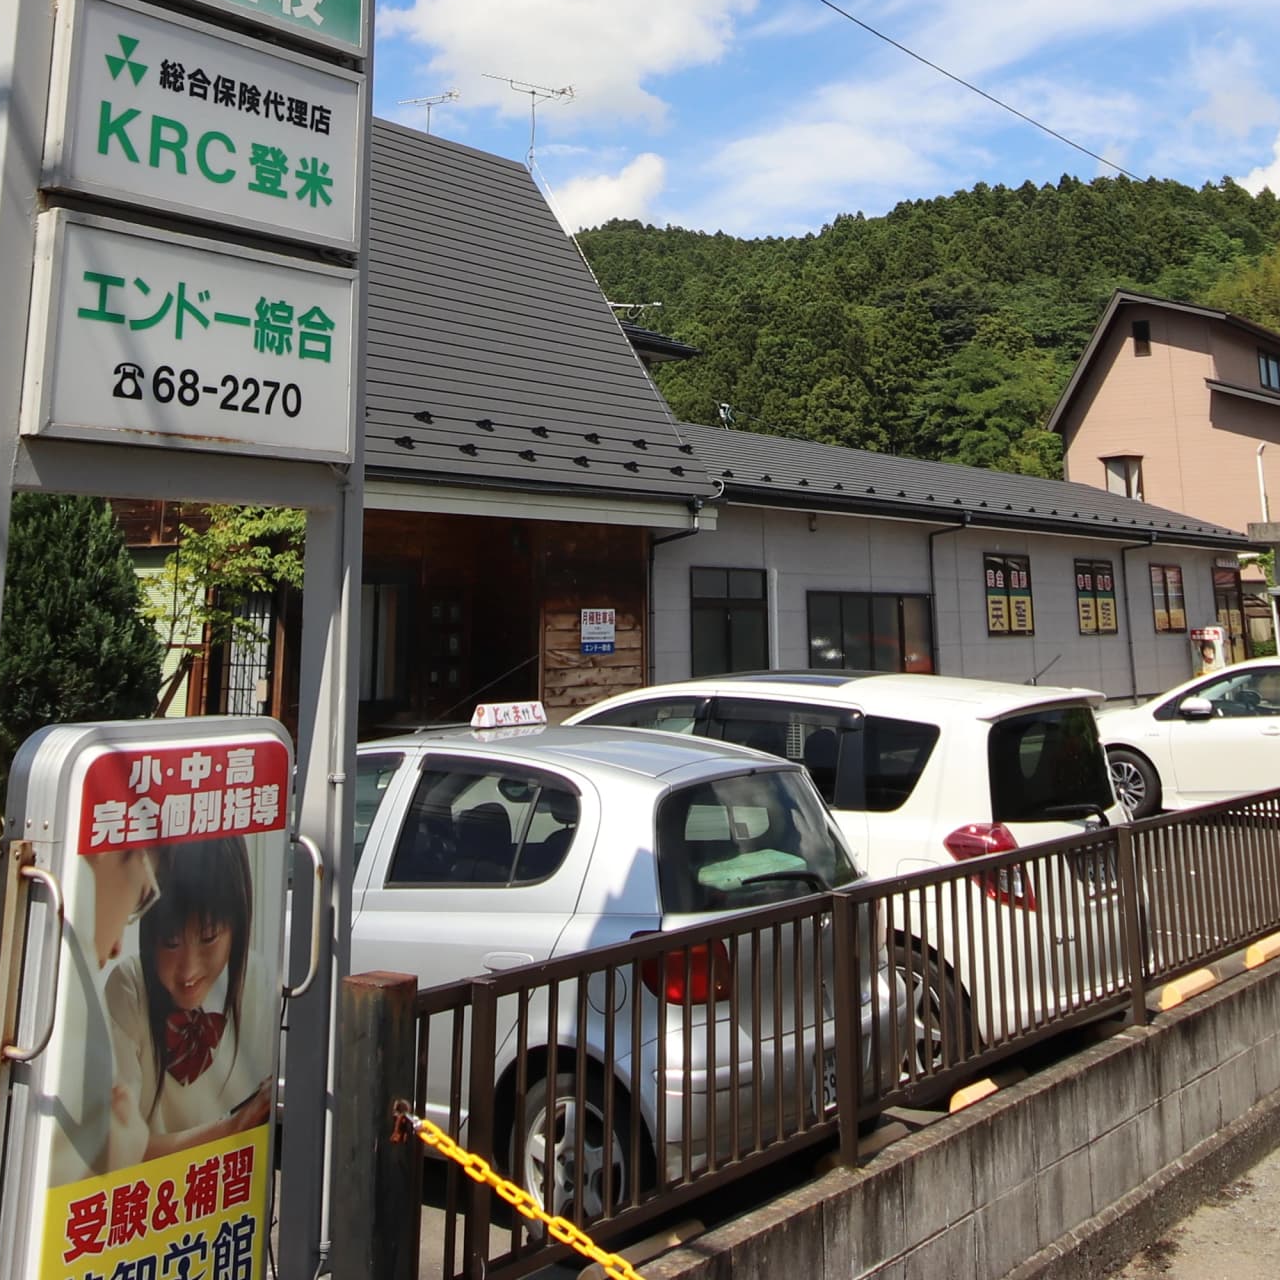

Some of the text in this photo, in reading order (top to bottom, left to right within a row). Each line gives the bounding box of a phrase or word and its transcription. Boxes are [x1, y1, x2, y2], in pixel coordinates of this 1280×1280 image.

[159, 58, 332, 135] 総合保険代理店
[77, 270, 336, 364] エンドー綜合
[152, 364, 302, 418] 68-2270
[128, 747, 256, 795] 小・中・高
[91, 783, 280, 848] 完全個別指導
